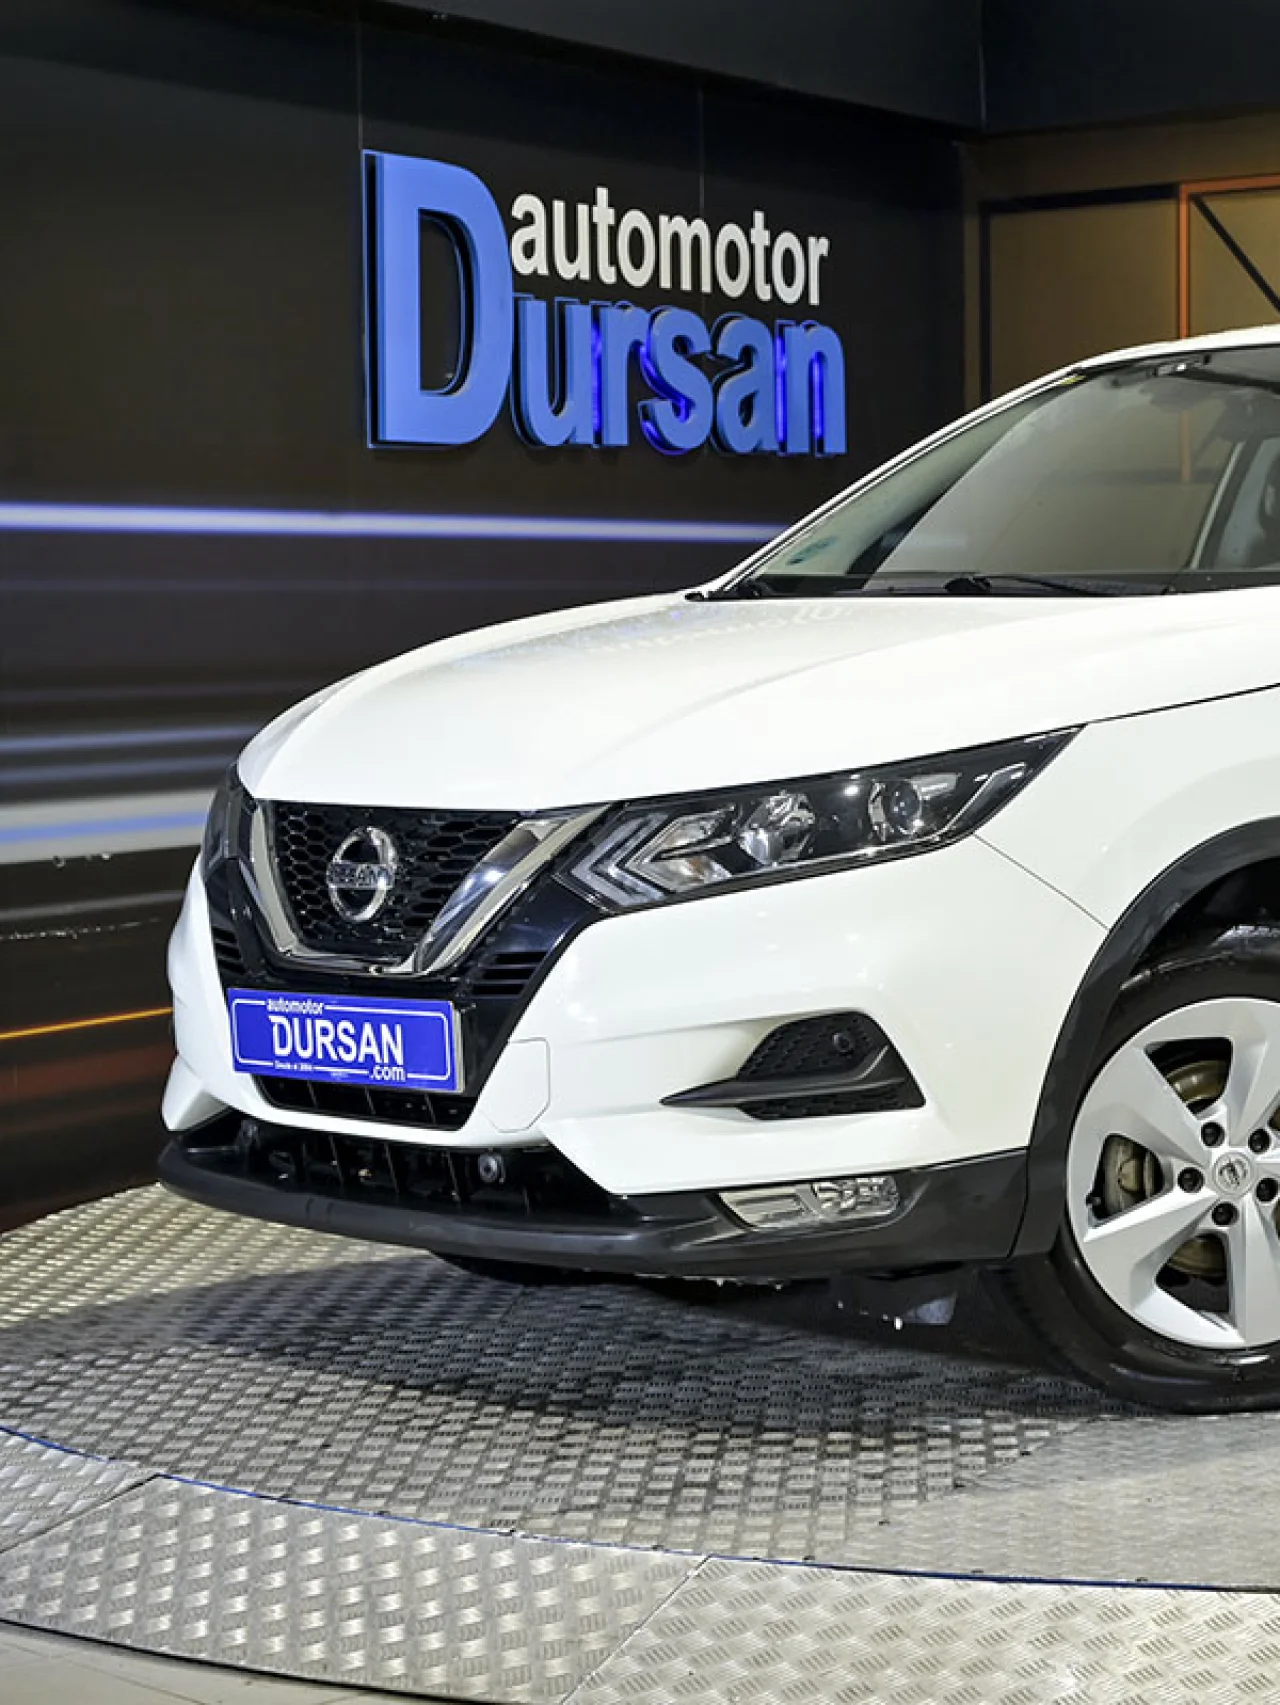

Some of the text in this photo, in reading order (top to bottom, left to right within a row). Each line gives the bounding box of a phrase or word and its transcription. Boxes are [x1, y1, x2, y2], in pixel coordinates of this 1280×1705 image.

[511, 187, 829, 305] automotor
[363, 149, 847, 457] Dursan
[268, 1015, 404, 1066] DURSAN
[369, 1064, 406, 1081] .com
